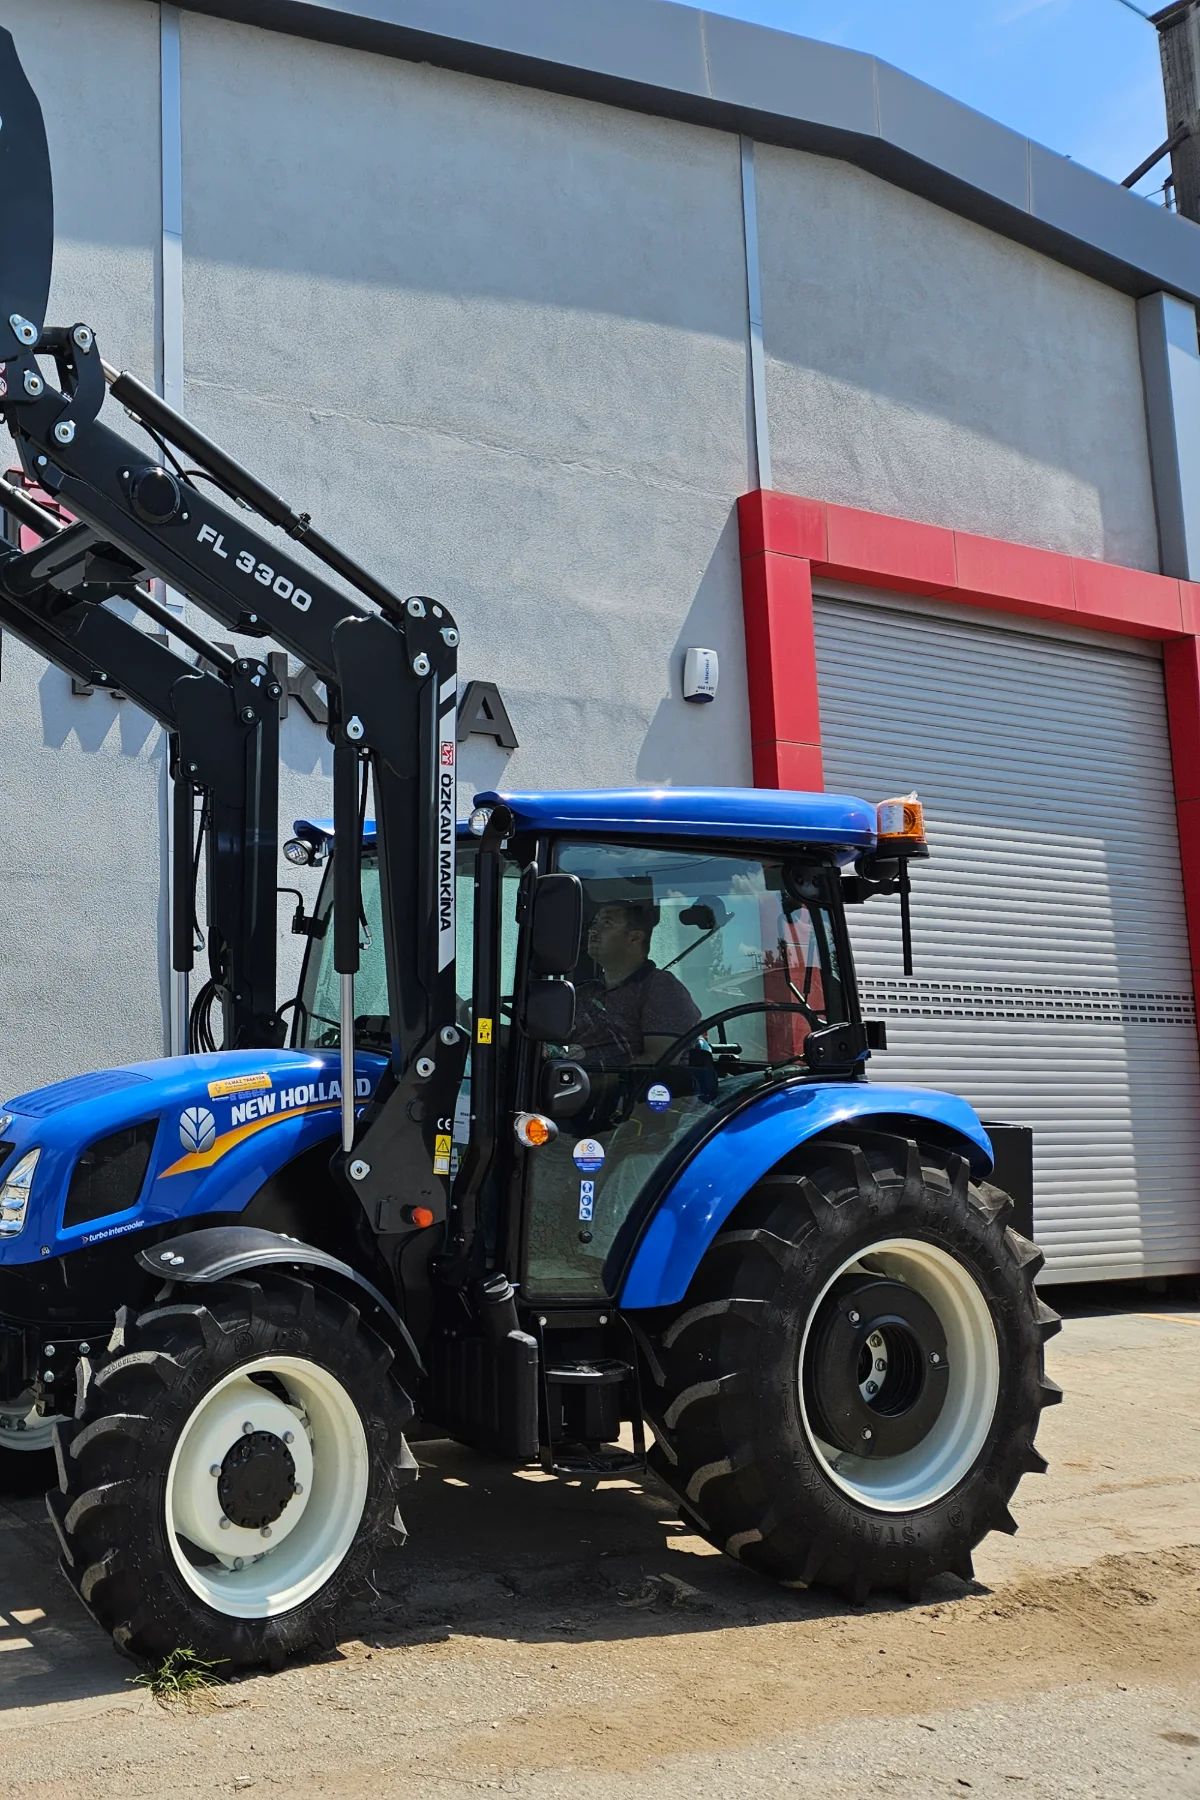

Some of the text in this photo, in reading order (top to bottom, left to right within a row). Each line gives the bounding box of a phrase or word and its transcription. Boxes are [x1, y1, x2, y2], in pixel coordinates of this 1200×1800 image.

[196, 523, 312, 612] FL 3300
[440, 773, 454, 845] ÖZKAN
[440, 850, 454, 932] MAKİNA
[231, 1078, 371, 1126] NEW HOLLAD
[437, 1117, 451, 1131] CE
[89, 1220, 145, 1242] turbo intercooler
